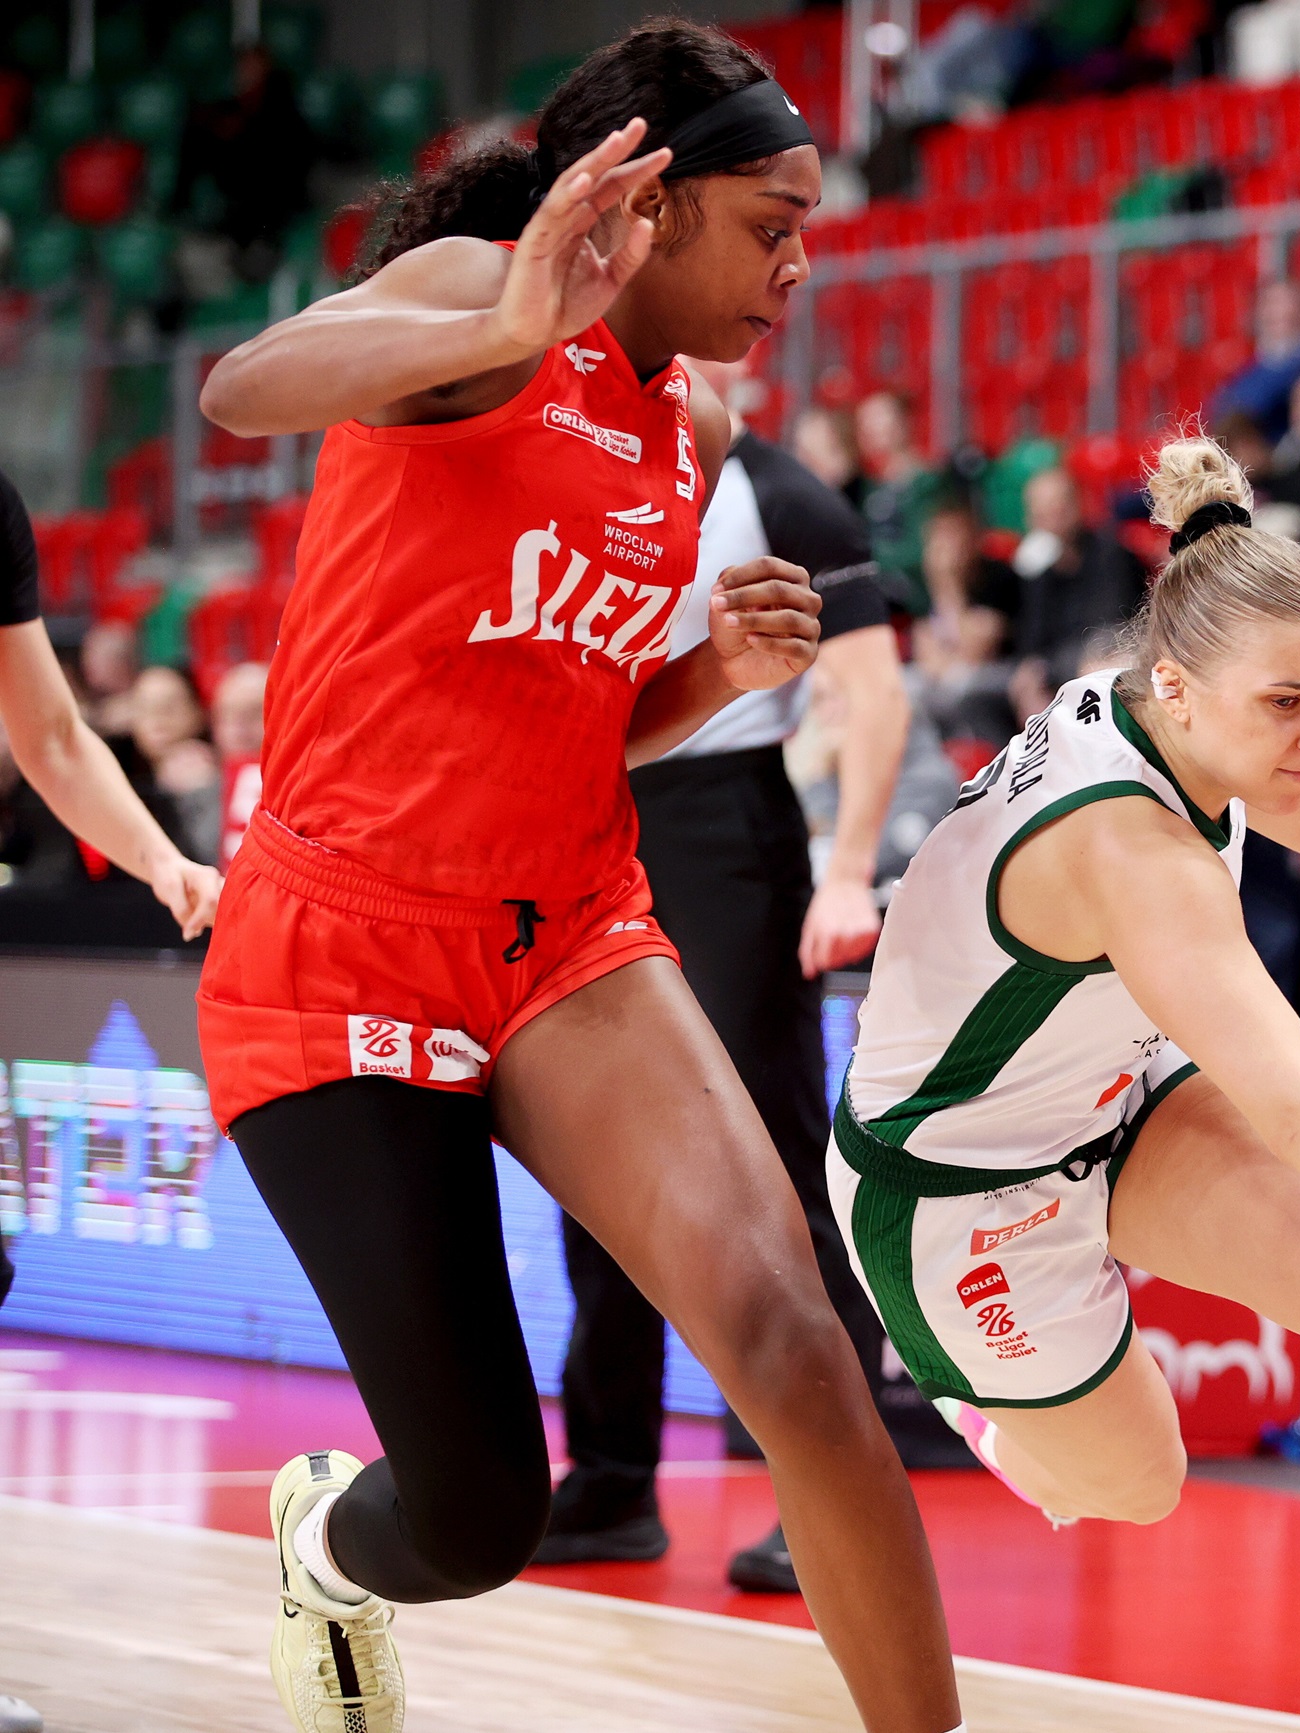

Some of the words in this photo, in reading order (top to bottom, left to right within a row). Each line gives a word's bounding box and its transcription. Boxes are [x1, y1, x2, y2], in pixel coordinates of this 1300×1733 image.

[550, 409, 594, 437] ORLEN
[604, 523, 665, 559] WROCLAW
[602, 541, 658, 572] AIRPORT
[359, 1061, 406, 1076] Basket
[982, 1209, 1049, 1250] PERŁA
[960, 1272, 1003, 1297] ORLEN
[985, 1331, 1029, 1348] Basket
[998, 1341, 1026, 1353] Liga
